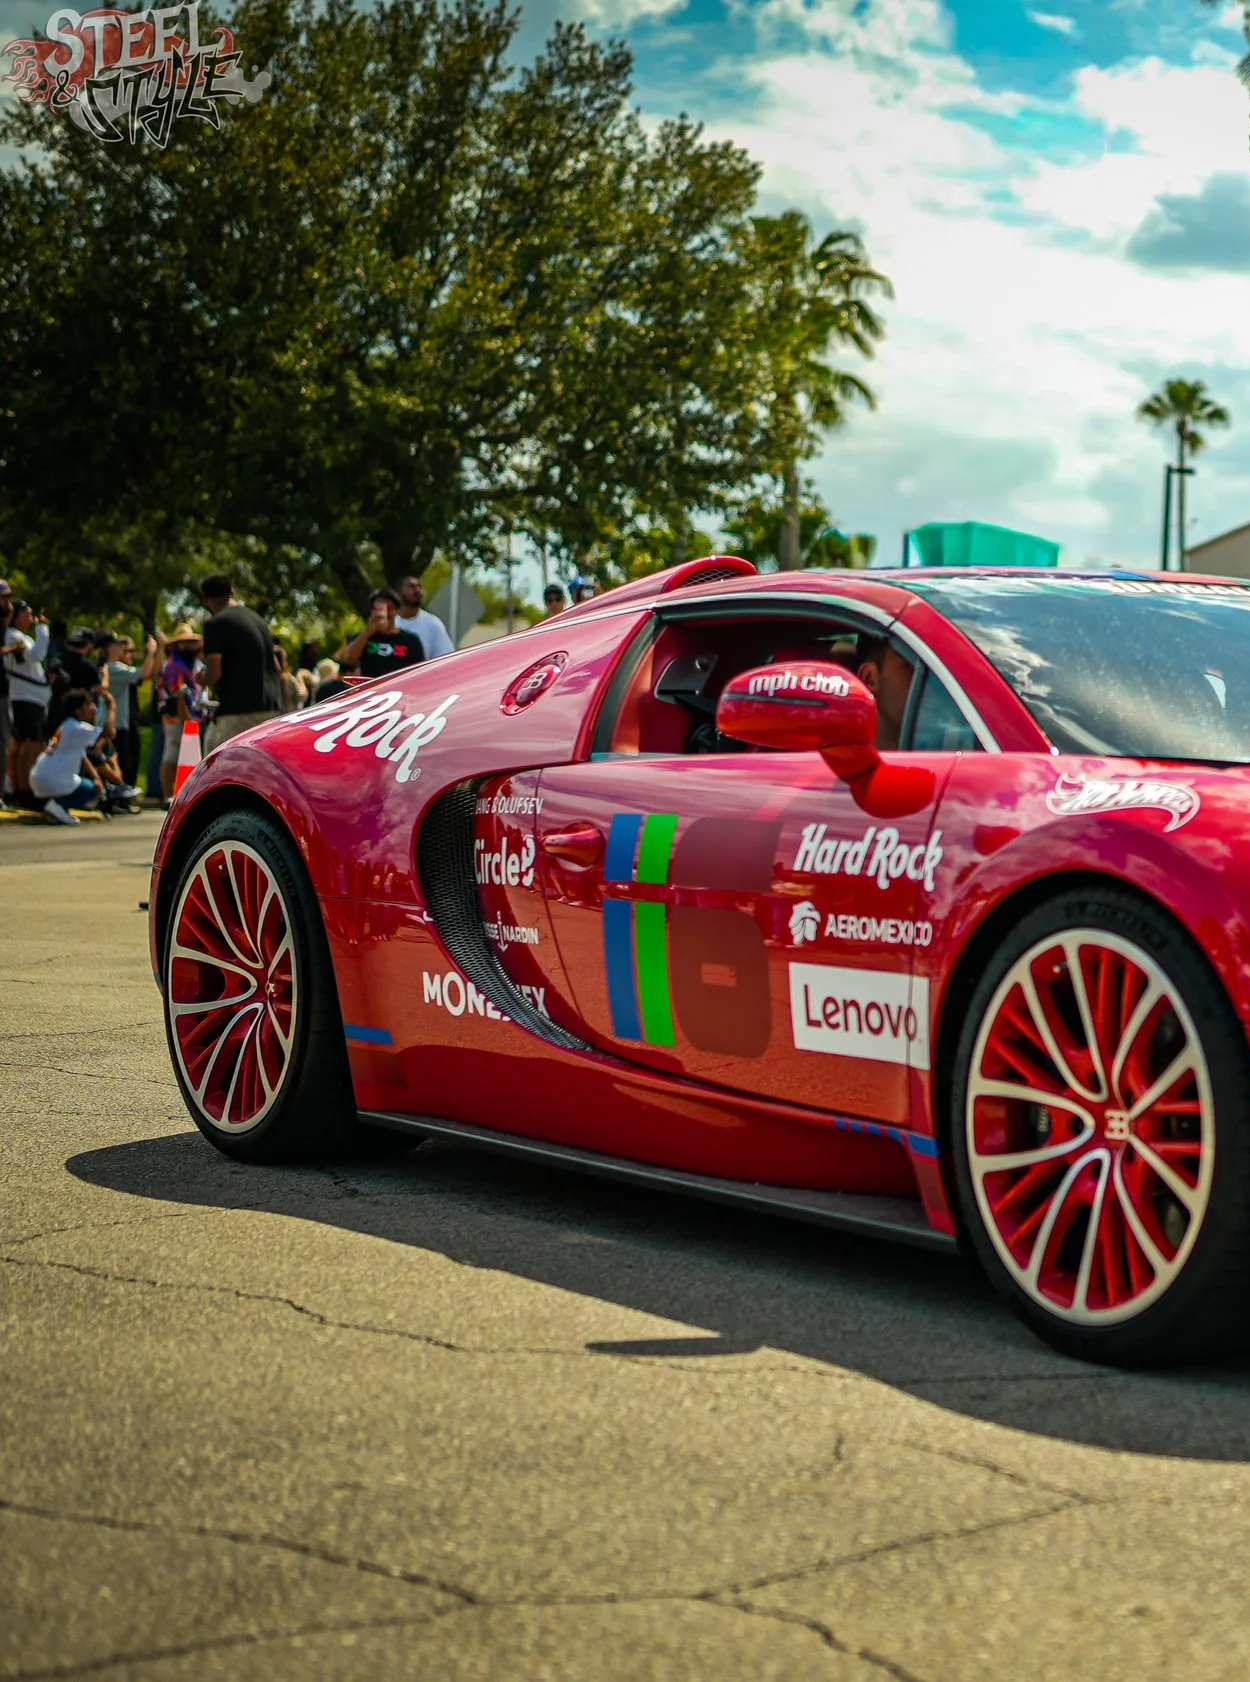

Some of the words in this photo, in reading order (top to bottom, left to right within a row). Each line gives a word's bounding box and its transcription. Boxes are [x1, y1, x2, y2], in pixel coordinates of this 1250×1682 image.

[749, 671, 798, 697] mph
[309, 691, 460, 783] Rock
[793, 822, 877, 877] Hard
[866, 826, 944, 892] Rock
[502, 925, 540, 945] NARDIN
[824, 913, 933, 947] AEROMEXICO
[803, 983, 918, 1042] Lenovo
